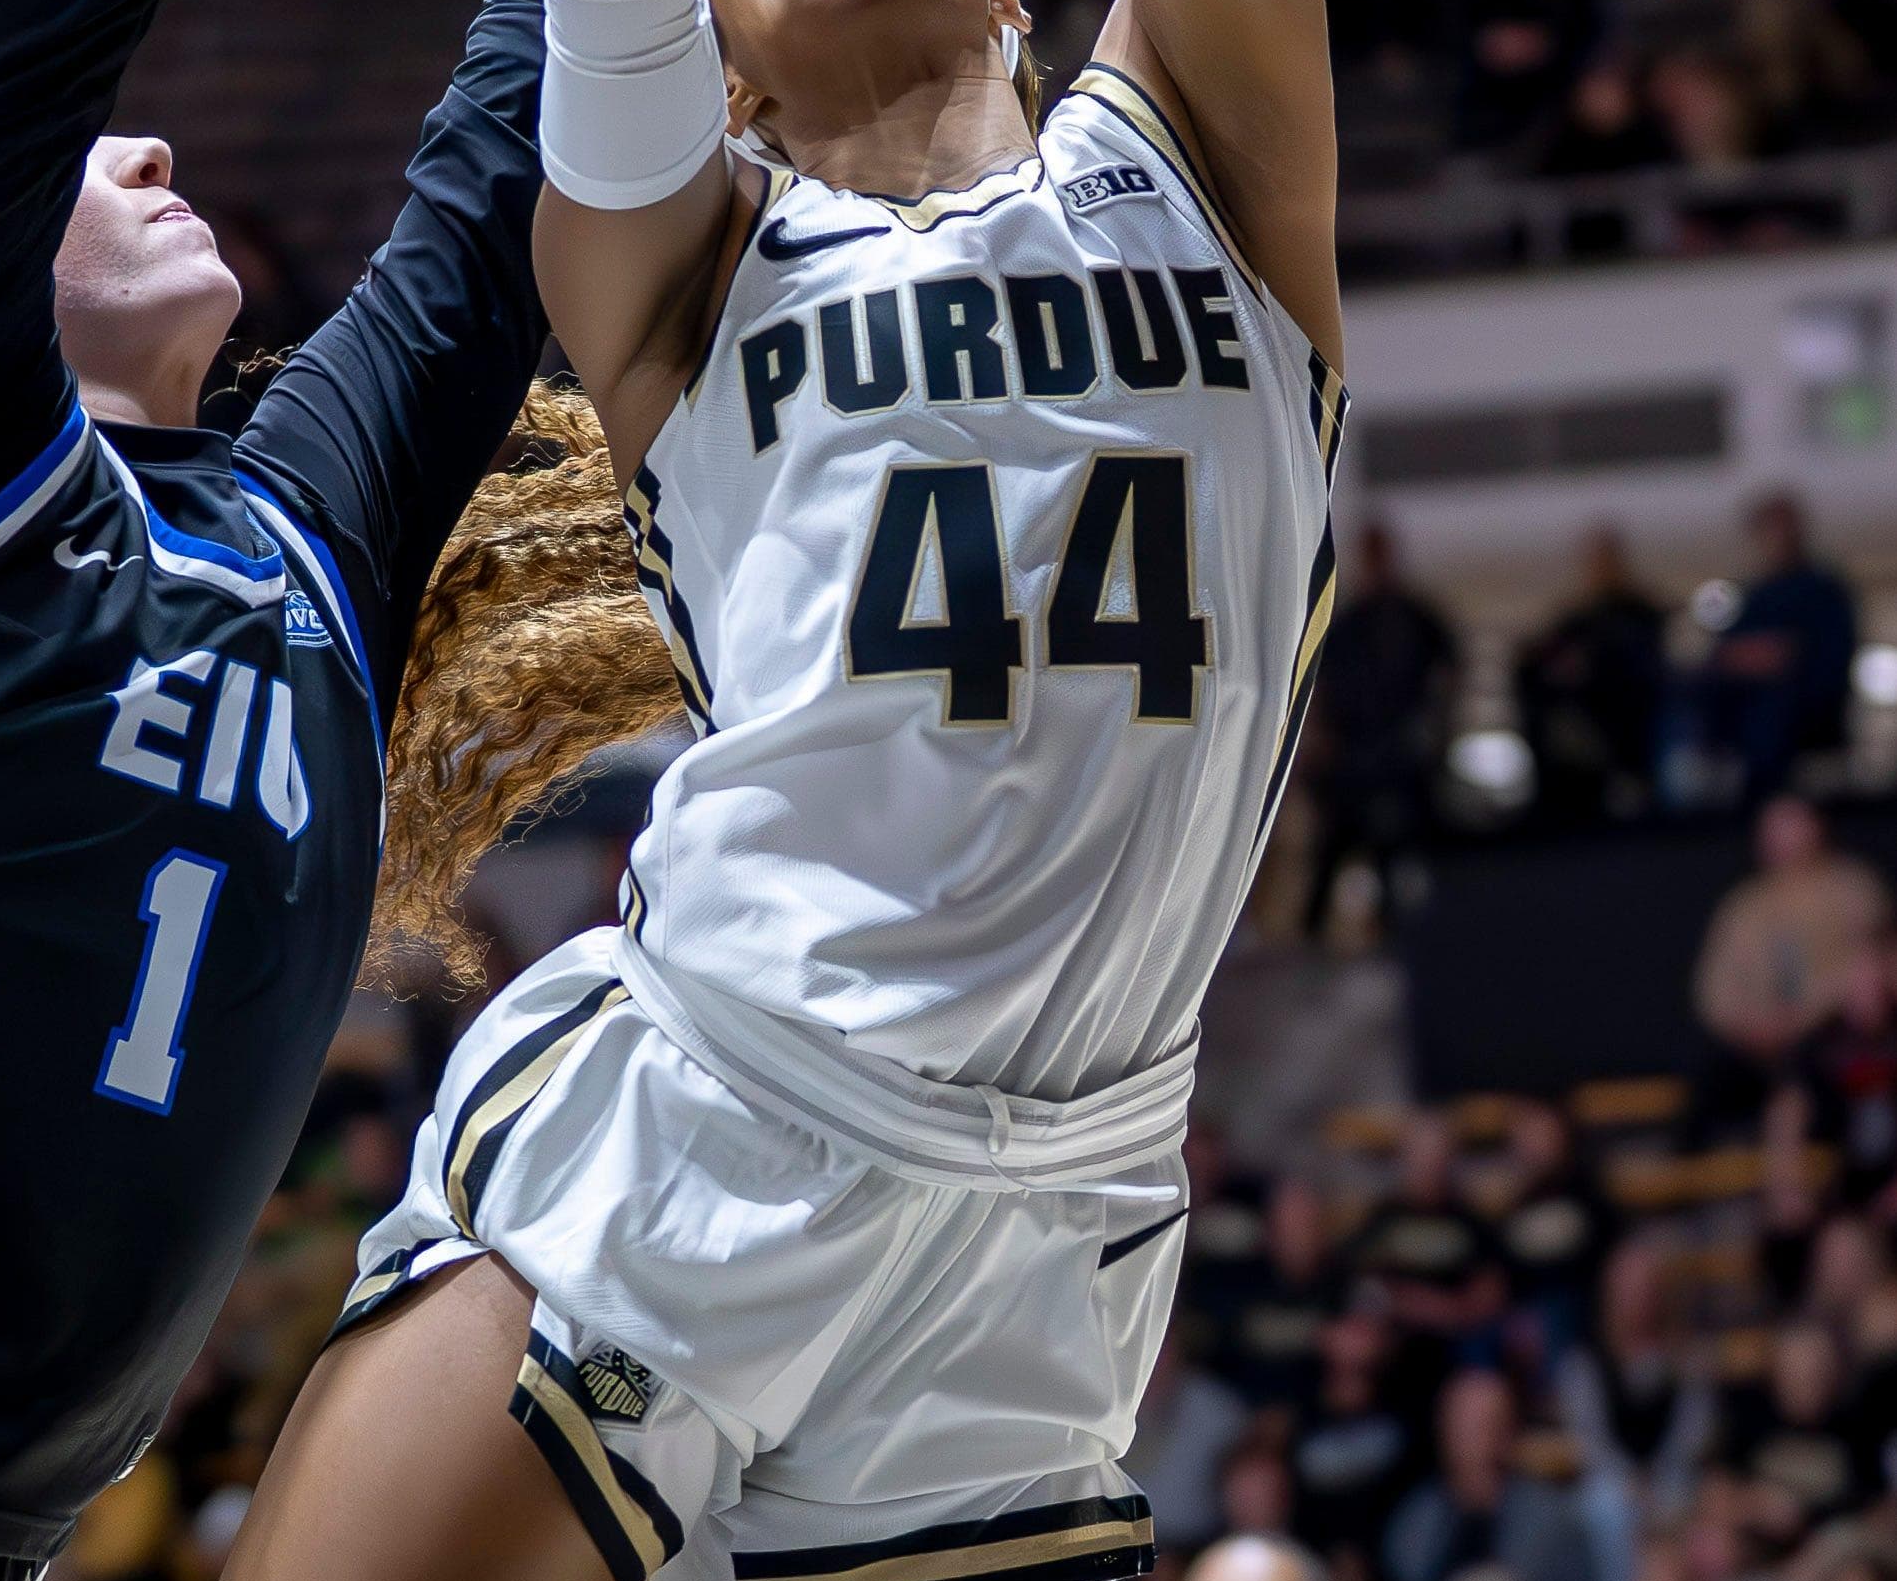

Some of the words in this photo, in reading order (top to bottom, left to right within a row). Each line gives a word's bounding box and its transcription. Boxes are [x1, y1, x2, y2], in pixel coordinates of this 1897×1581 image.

[738, 269, 1251, 457] PURDUE
[841, 447, 1215, 729] 44
[93, 846, 229, 1116] 1
[578, 1362, 646, 1418] PURDUE
